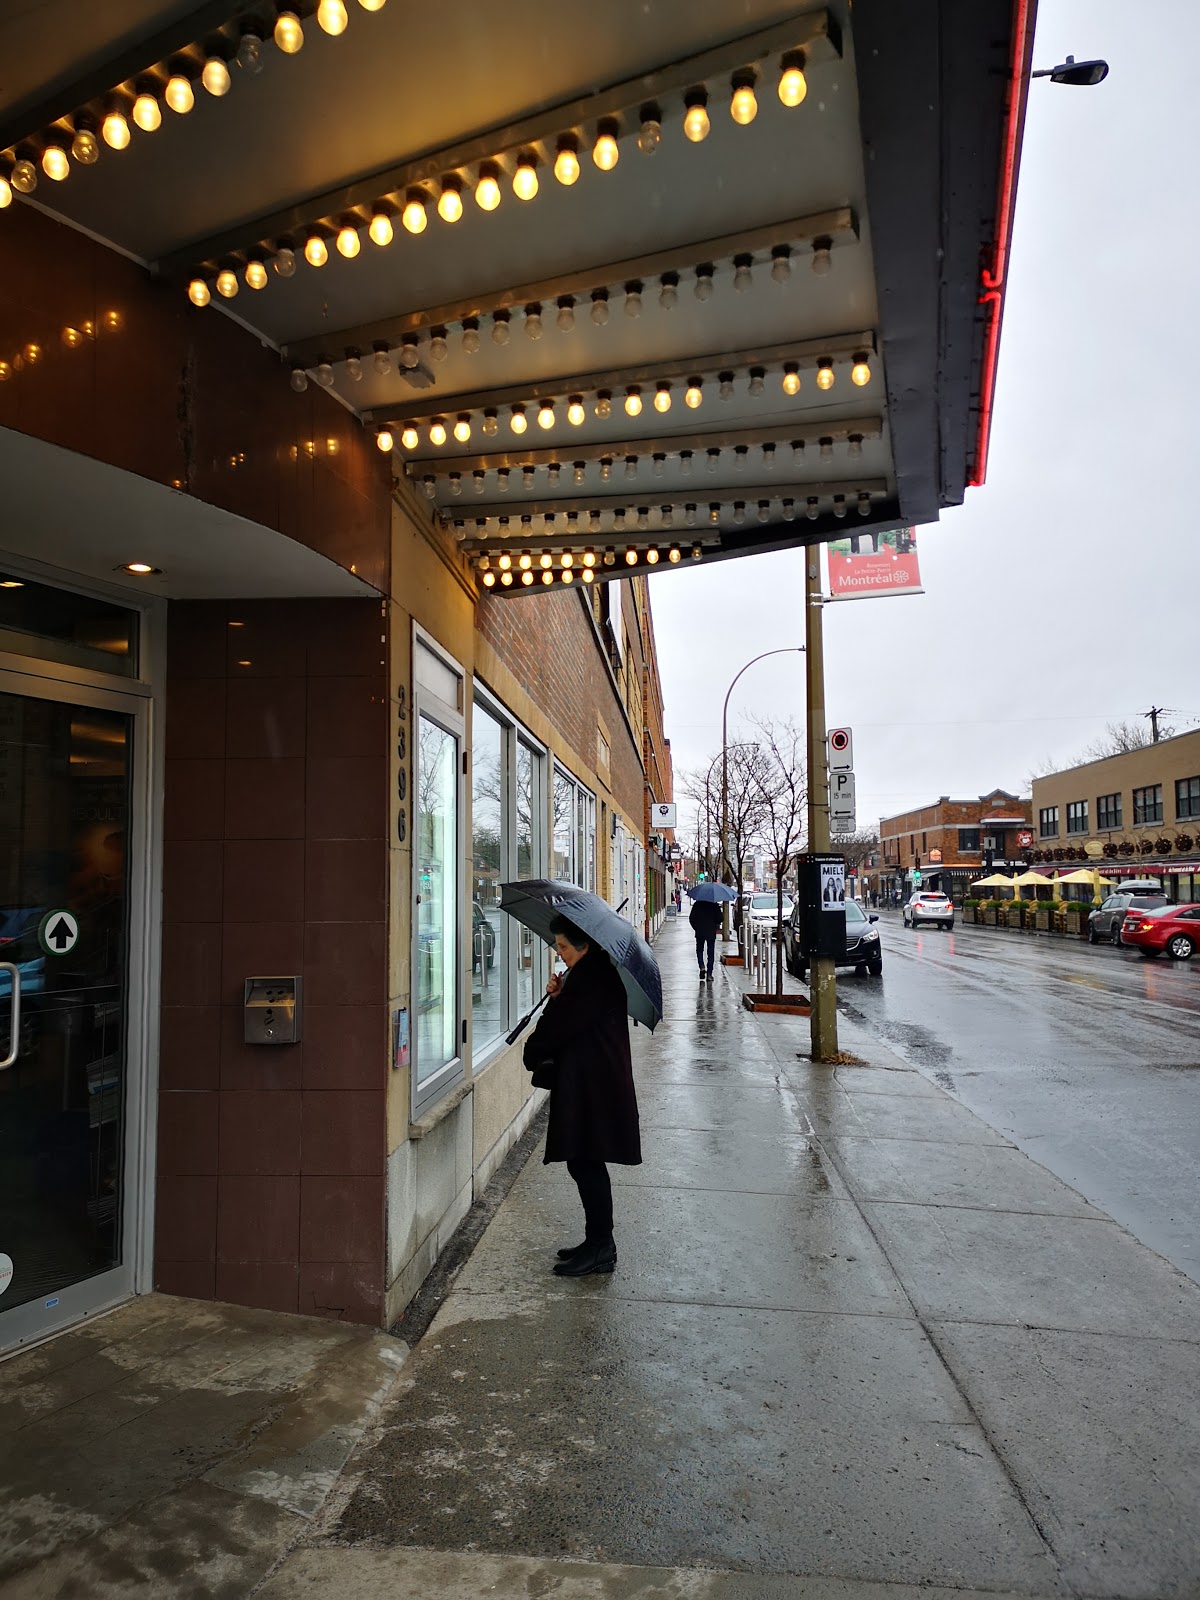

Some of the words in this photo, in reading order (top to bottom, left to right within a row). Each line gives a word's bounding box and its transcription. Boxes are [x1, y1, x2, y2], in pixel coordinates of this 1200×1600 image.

[839, 574, 893, 586] Montréal
[398, 684, 406, 842] 2396
[838, 775, 847, 791] P
[823, 866, 843, 875] MIELS
